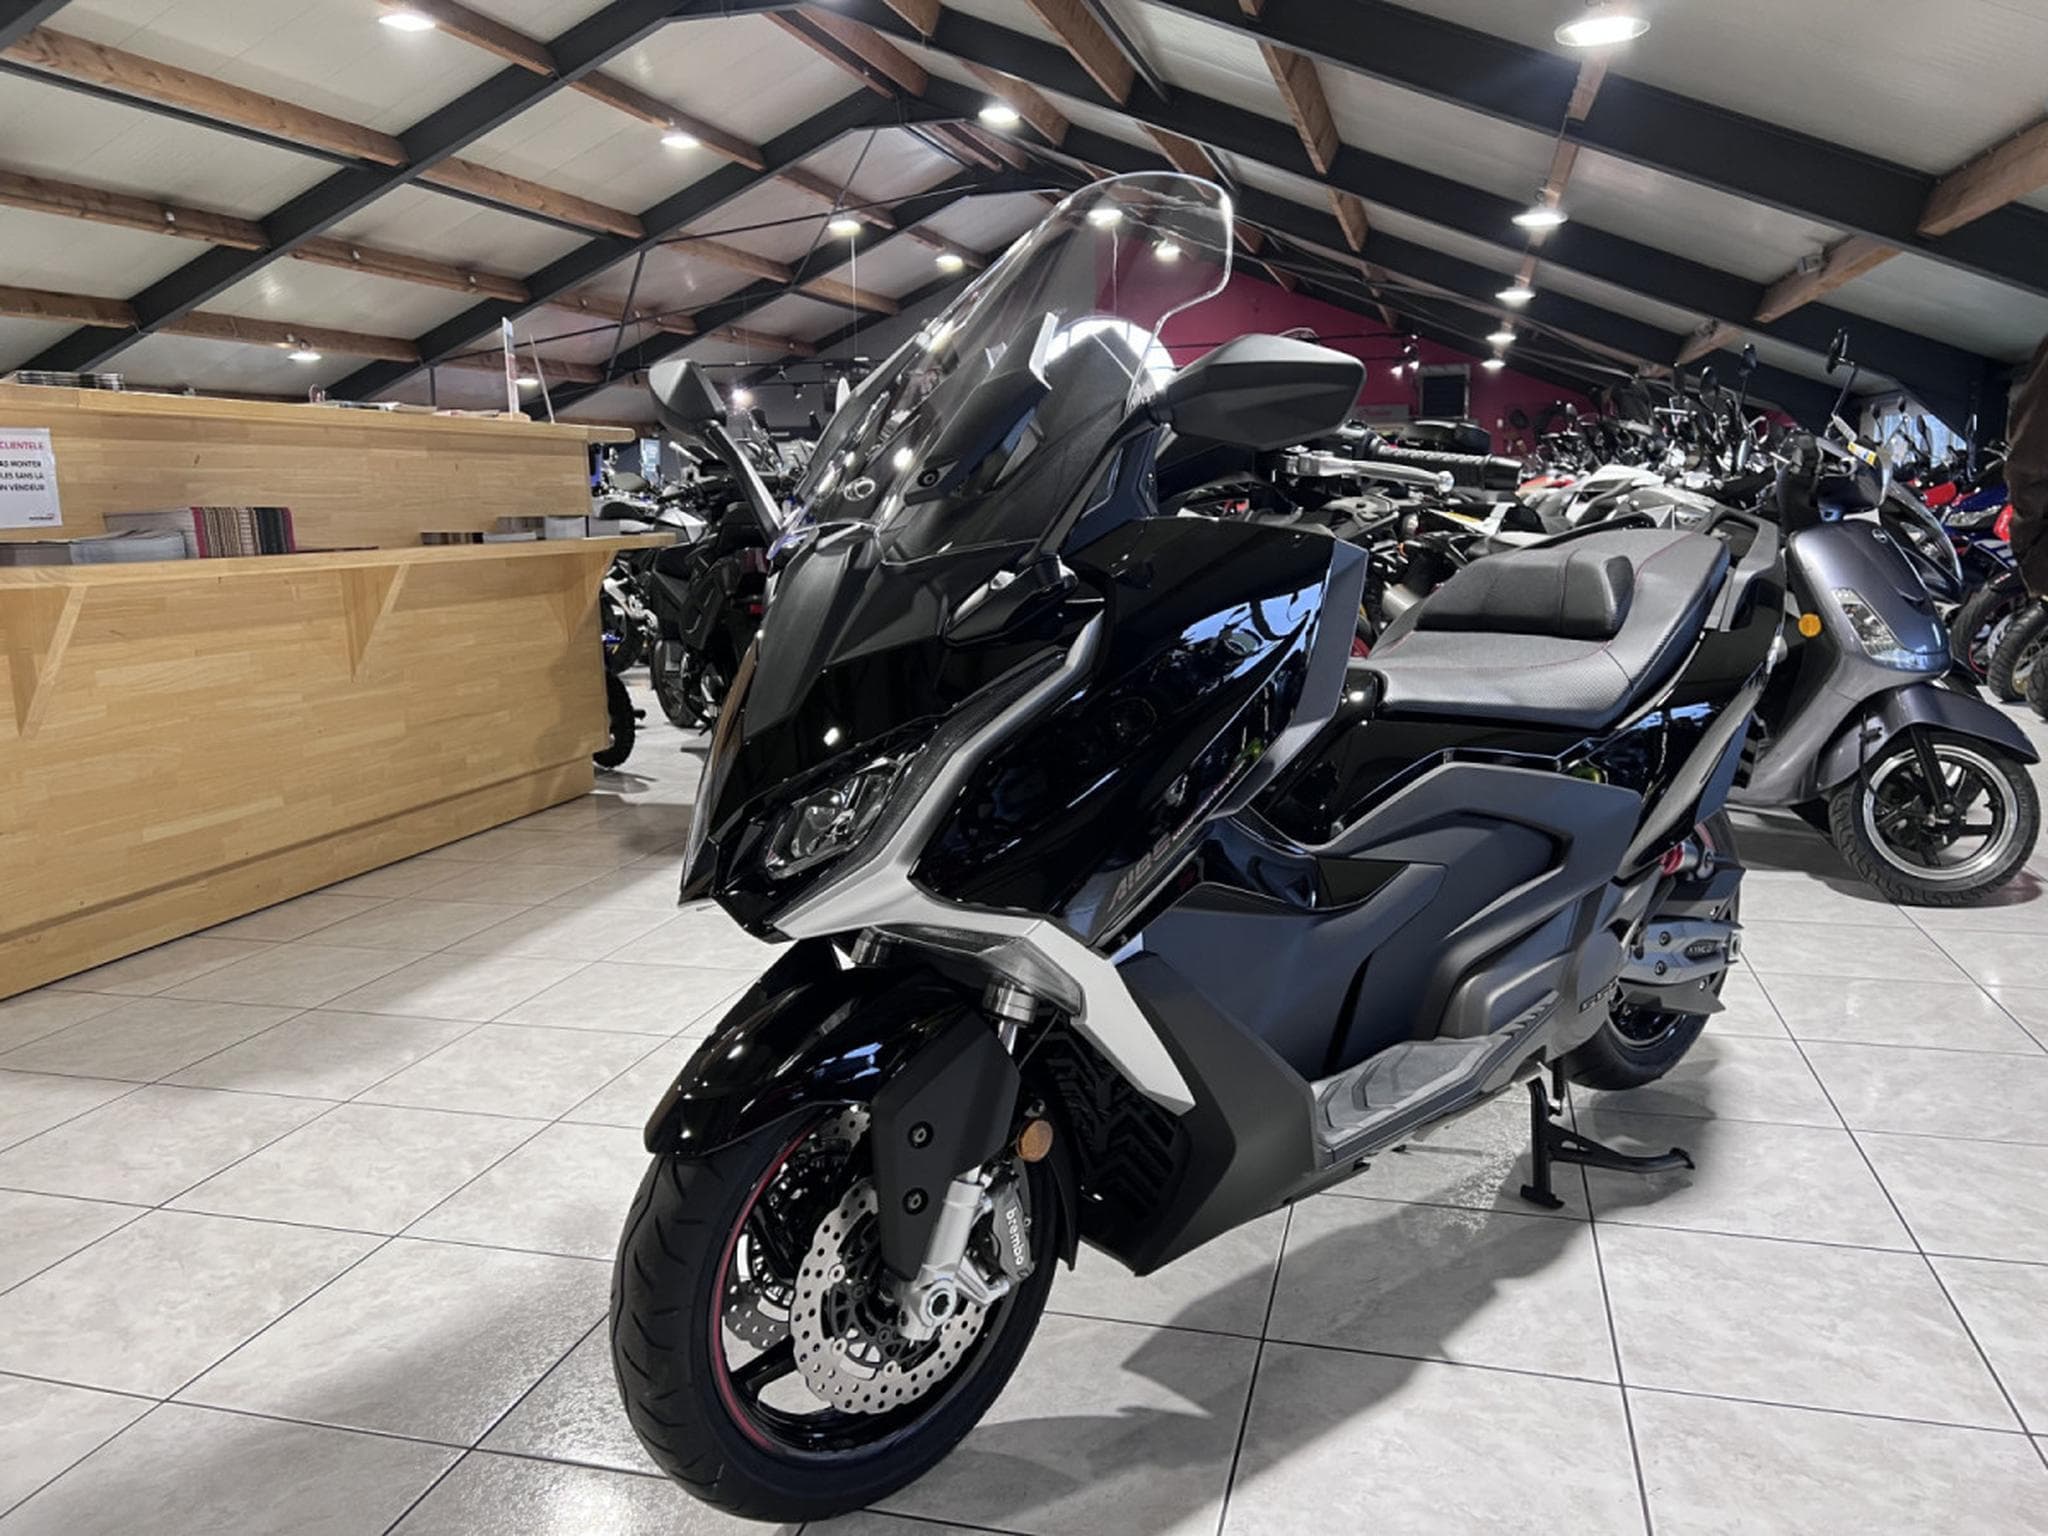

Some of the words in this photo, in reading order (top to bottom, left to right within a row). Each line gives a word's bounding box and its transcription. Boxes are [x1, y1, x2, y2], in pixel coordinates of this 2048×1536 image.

[10, 460, 41, 468] MONTER
[15, 472, 33, 480] SANS
[8, 483, 45, 492] VENDEUR
[1006, 1206, 1025, 1266] brembo
